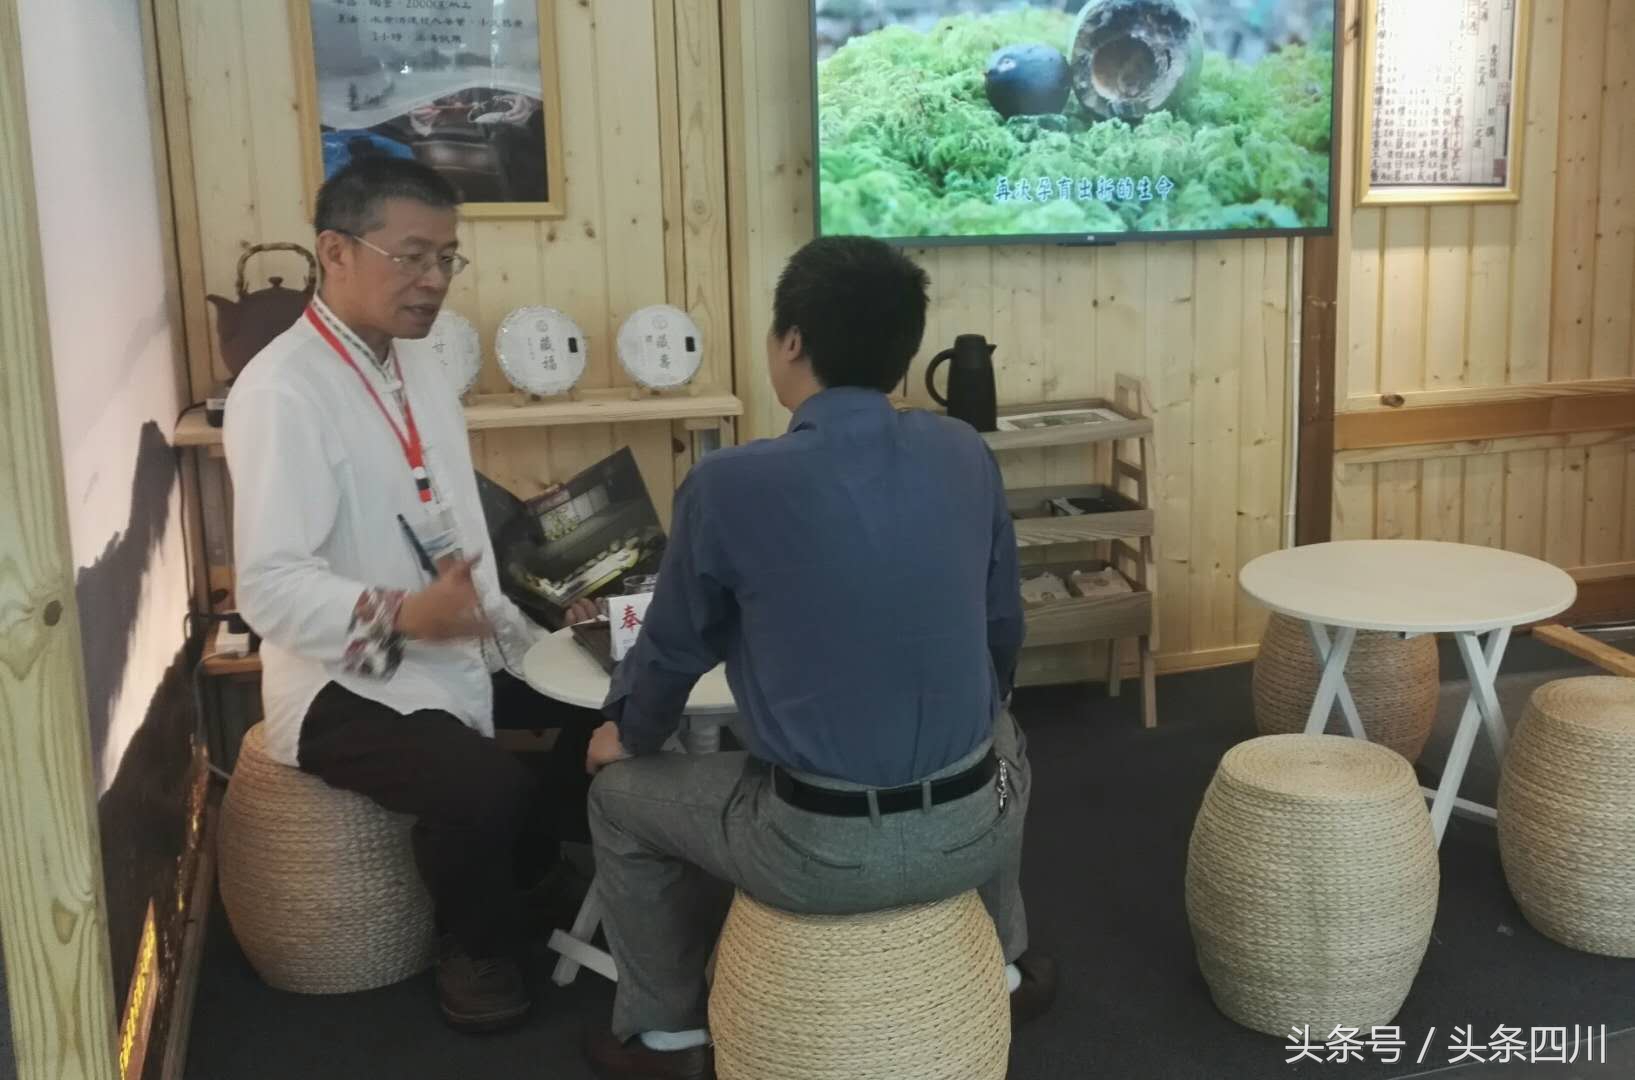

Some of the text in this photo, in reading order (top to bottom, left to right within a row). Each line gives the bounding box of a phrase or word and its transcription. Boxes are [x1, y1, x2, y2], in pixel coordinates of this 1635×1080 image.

[994, 176, 1174, 201] 再次孕育出新的生命
